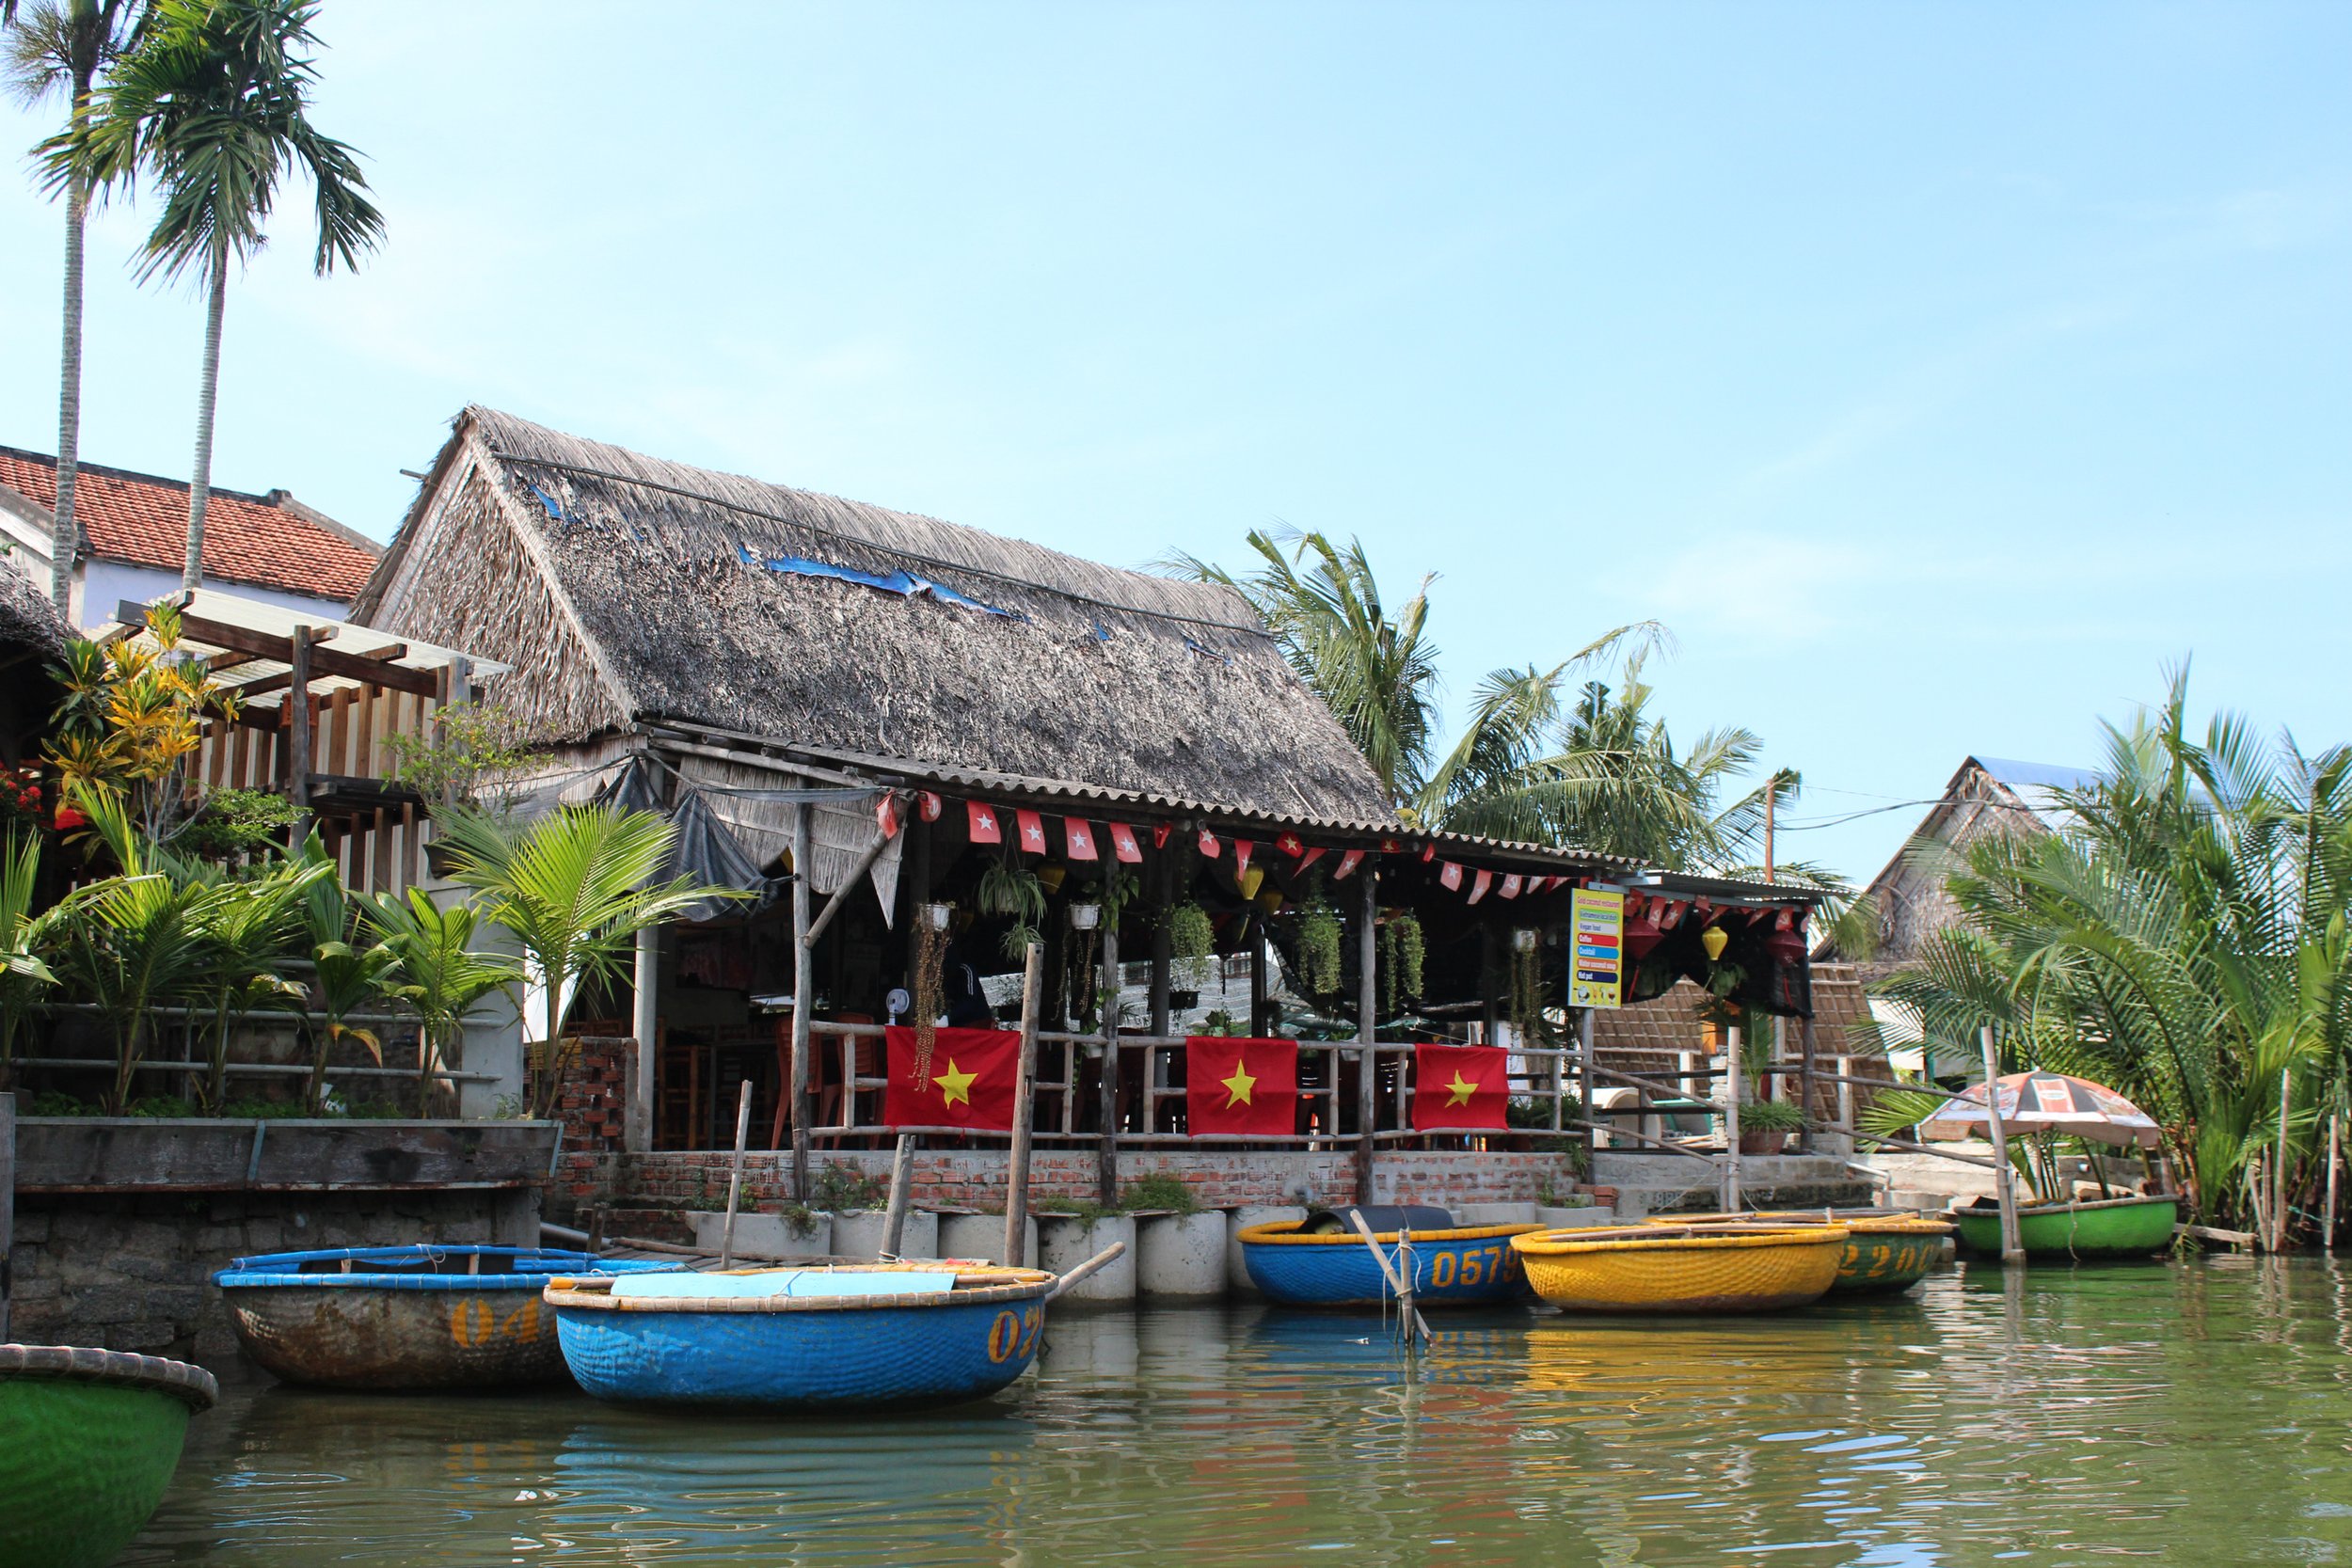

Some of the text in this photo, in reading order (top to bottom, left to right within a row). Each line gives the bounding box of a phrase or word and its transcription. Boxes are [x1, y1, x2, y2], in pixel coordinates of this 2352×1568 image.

[1579, 934, 1593, 943] Coffee
[1579, 946, 1597, 957] Cocktail
[452, 1296, 558, 1349] 04
